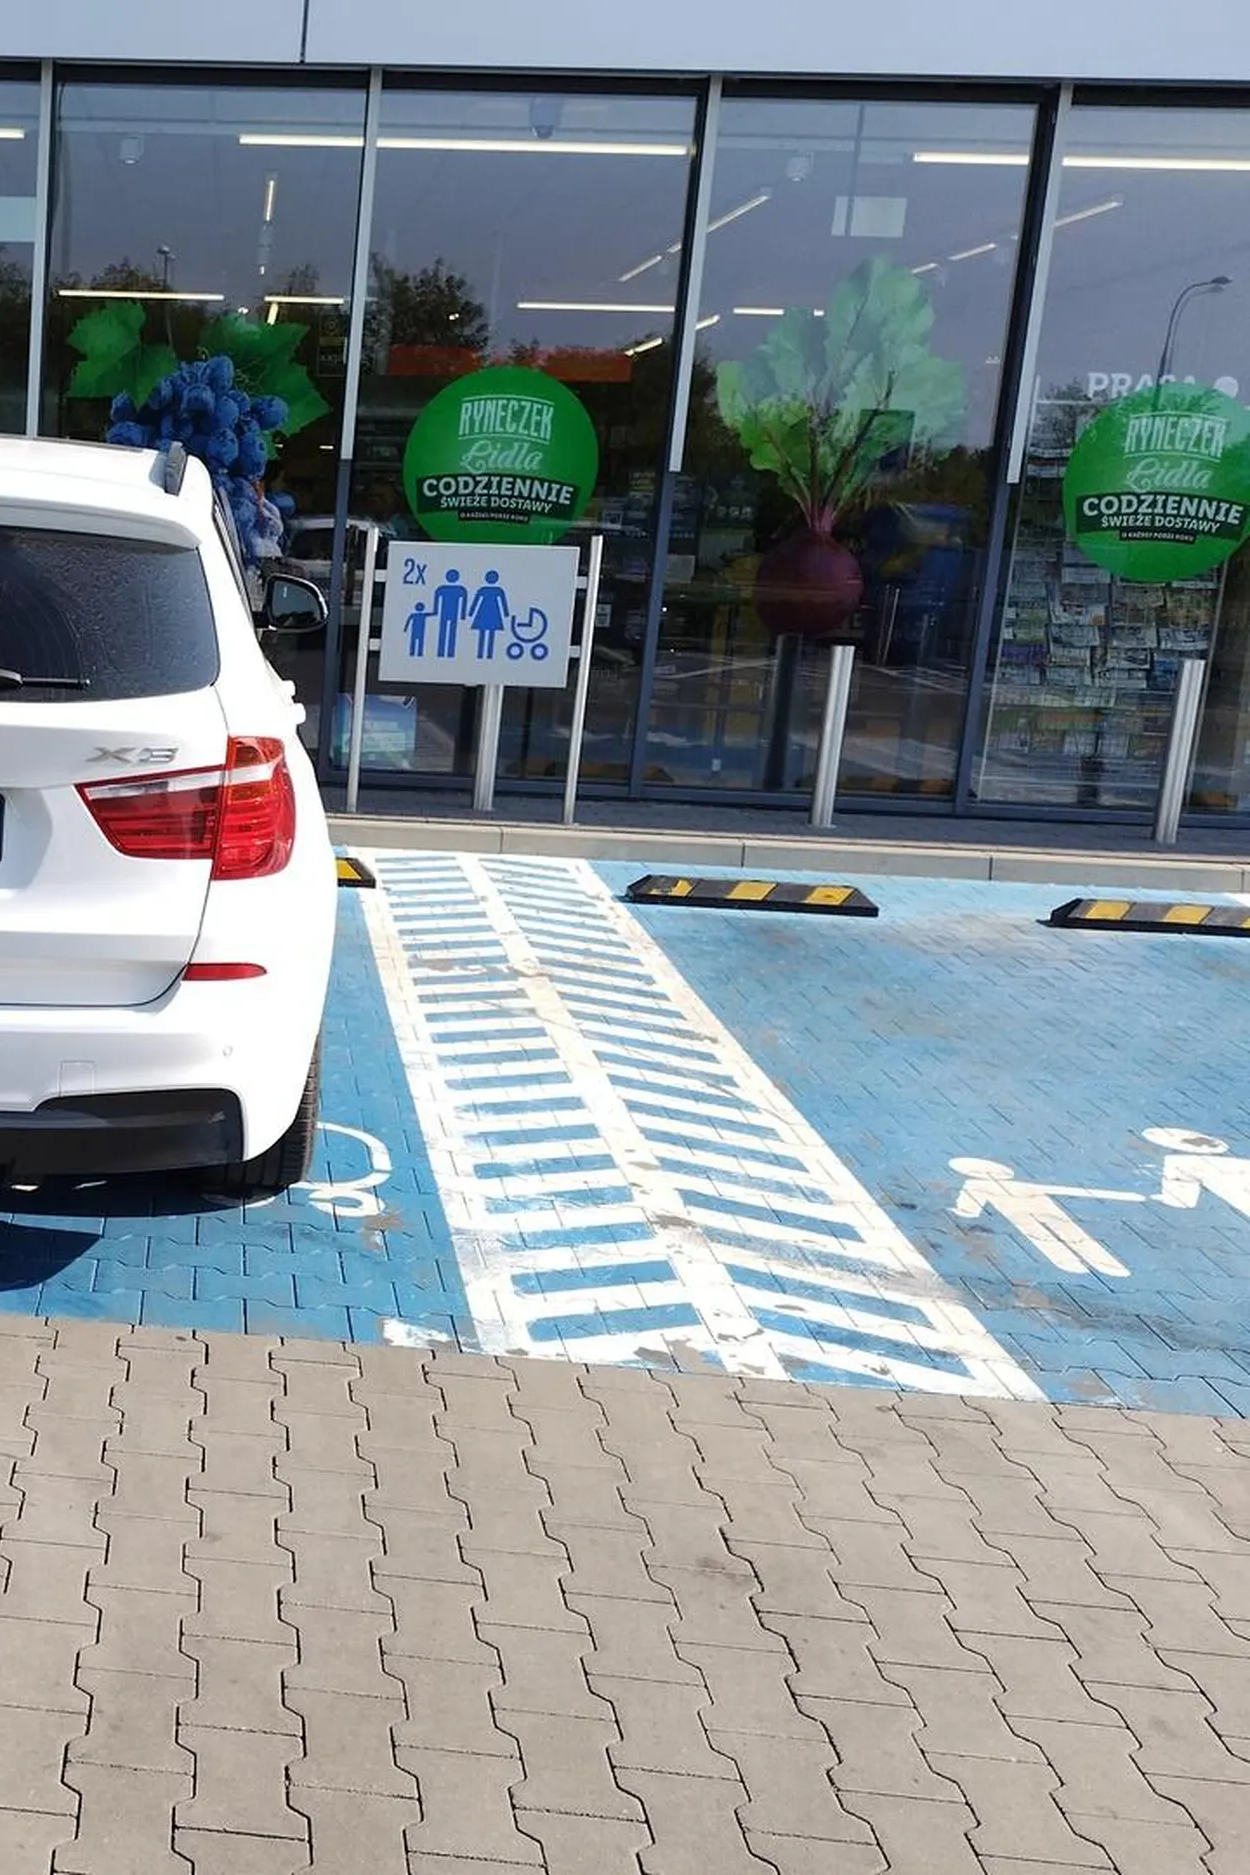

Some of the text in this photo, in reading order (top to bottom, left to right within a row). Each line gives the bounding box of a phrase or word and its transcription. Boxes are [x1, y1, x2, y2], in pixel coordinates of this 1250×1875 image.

[458, 399, 554, 440] RYNECZEK
[1124, 415, 1227, 458] RYNECZEK
[460, 440, 543, 475] Lidla
[1125, 457, 1214, 493] Lidla
[422, 476, 574, 505] CODZIENNIE
[439, 494, 553, 514] ŚWIEŻE DOSTAWY
[1082, 494, 1245, 525] CODZIENNIE
[1101, 513, 1220, 534] ŚWIEŻE DOSTAWY
[403, 558, 427, 585] 2x
[85, 746, 179, 764] X3
